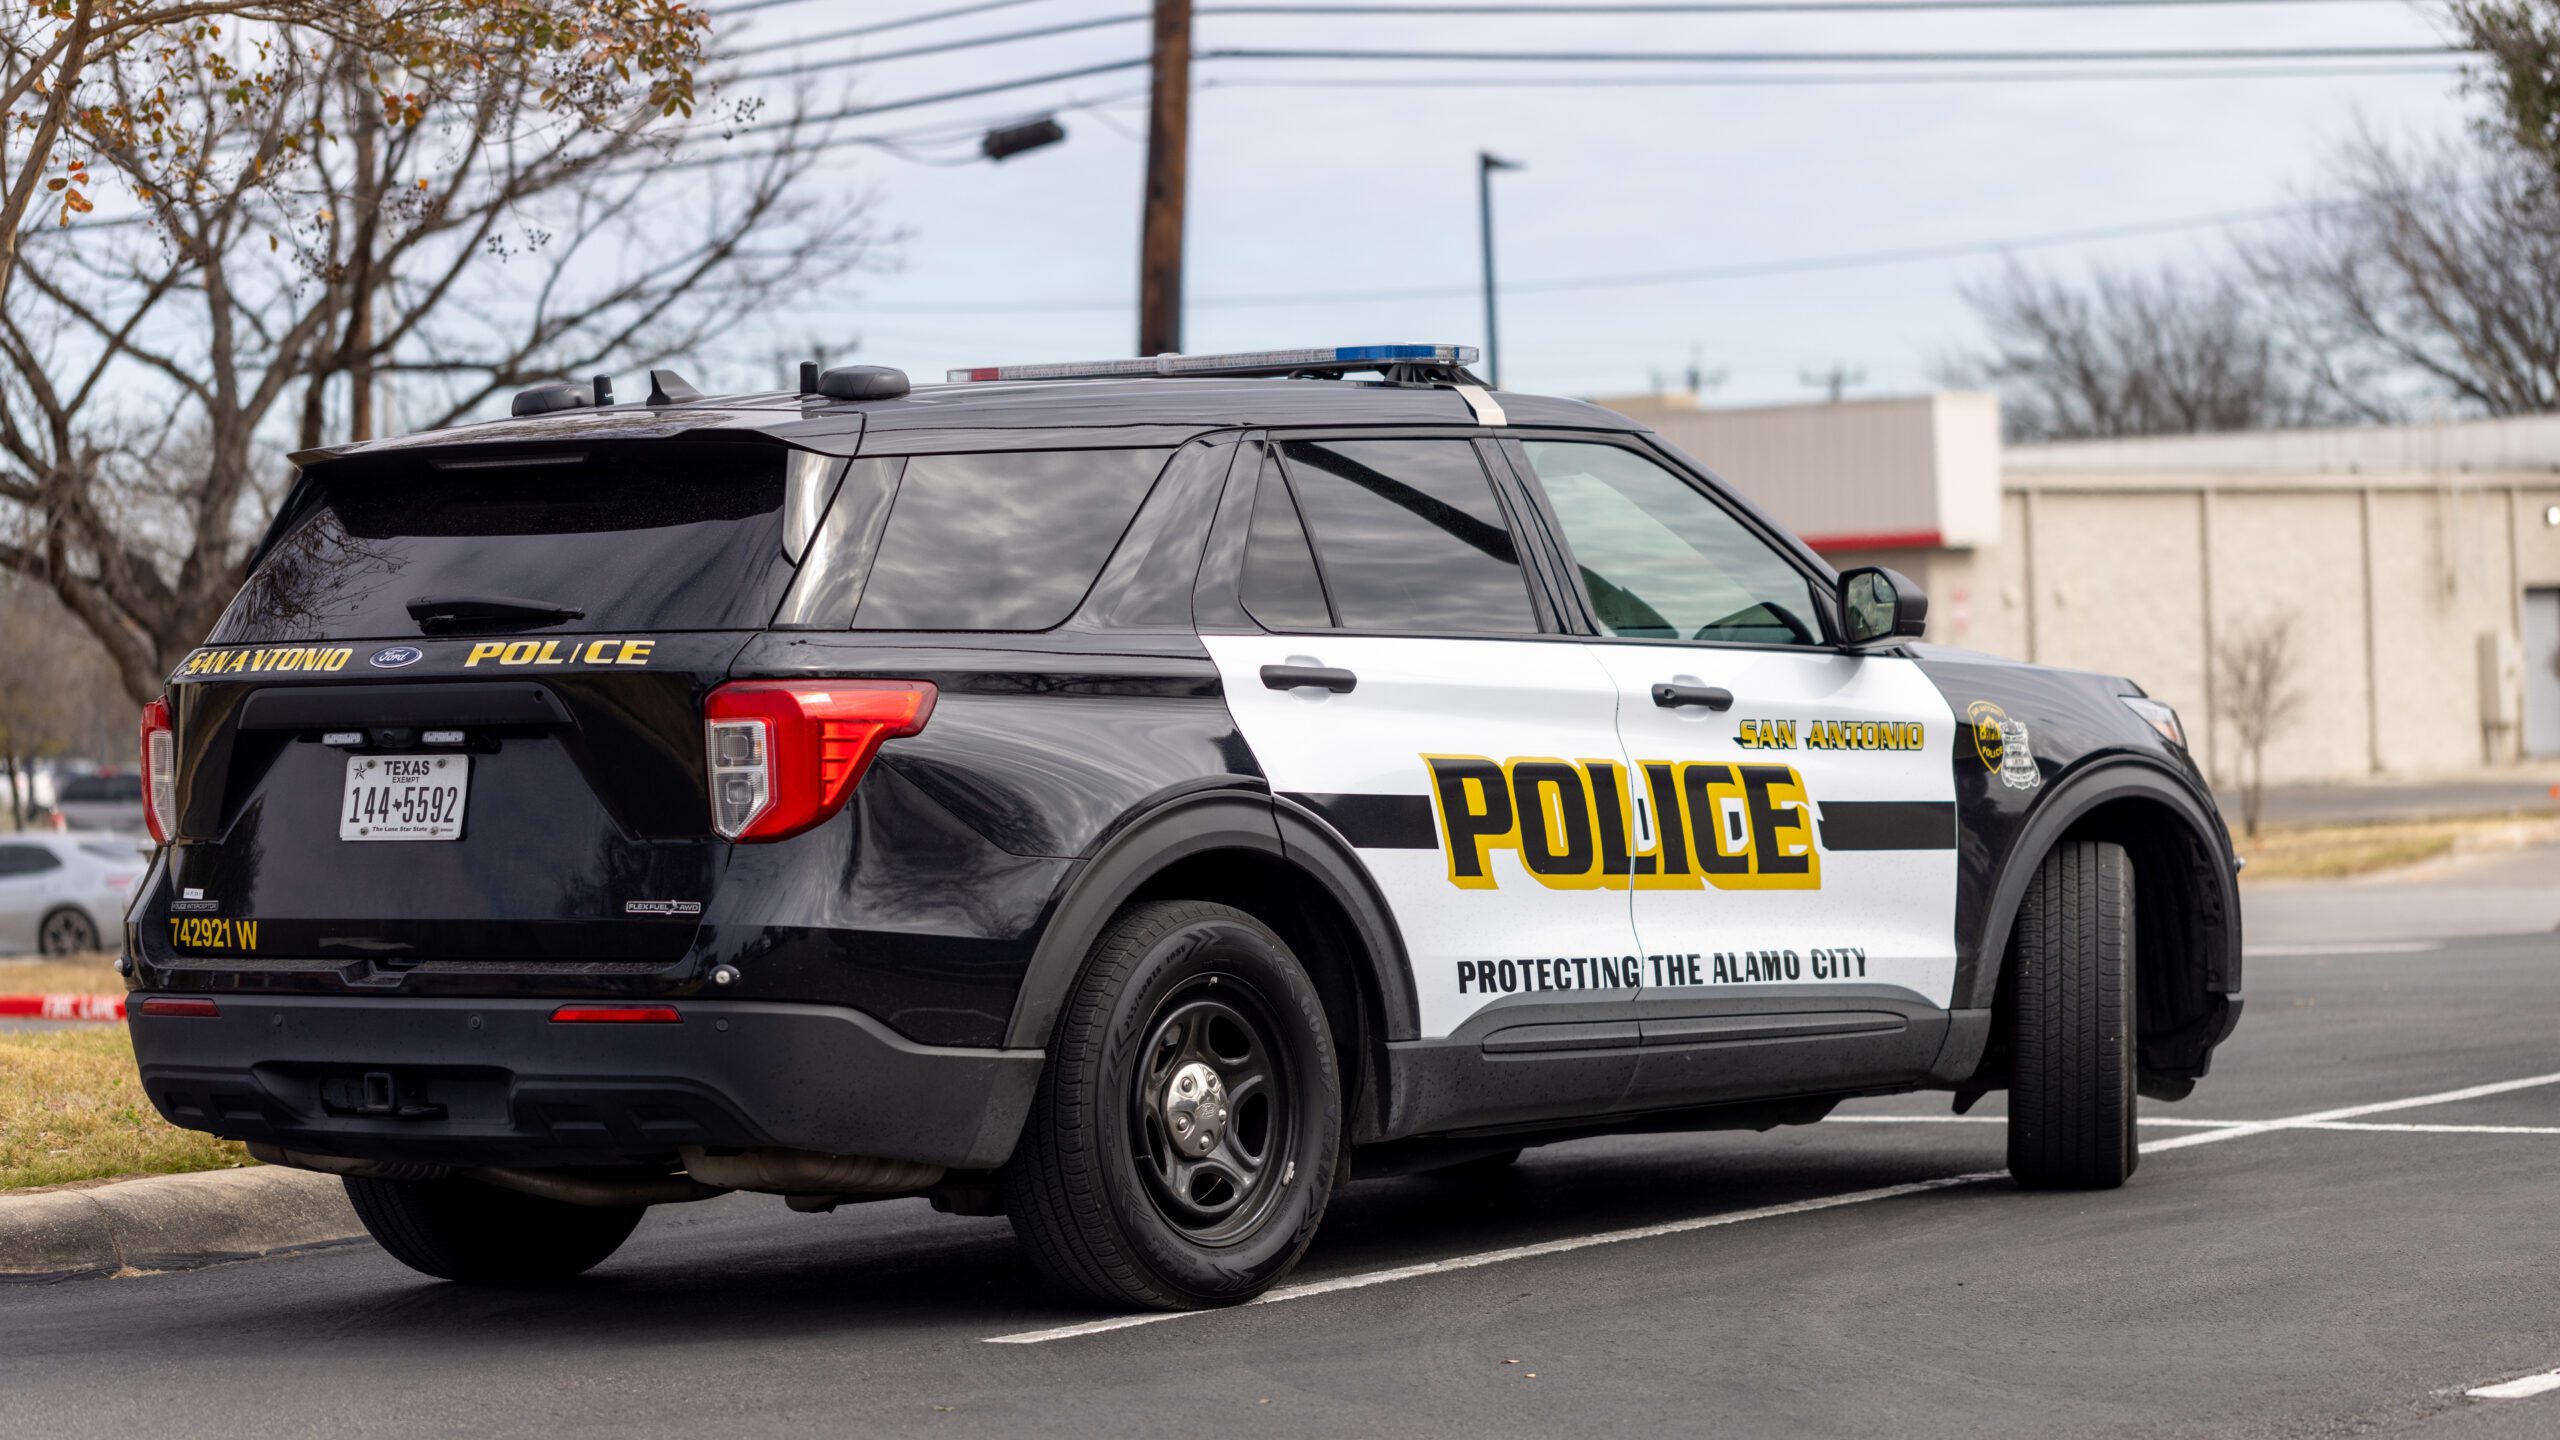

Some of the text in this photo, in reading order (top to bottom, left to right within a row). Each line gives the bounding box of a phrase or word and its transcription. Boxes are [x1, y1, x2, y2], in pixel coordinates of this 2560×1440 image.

[184, 651, 236, 675] SAN
[379, 649, 410, 662] Ford
[464, 640, 656, 667] POLICE
[1734, 719, 1924, 751] SAN ANTONIO
[384, 760, 430, 776] TEXAS
[392, 776, 420, 784] EXEMPT
[1418, 752, 1821, 891] POLICE
[628, 903, 649, 911] FLEX
[170, 918, 257, 950] 742921 W
[1456, 947, 1867, 994] PROTECTING THE ALAMO CITY
